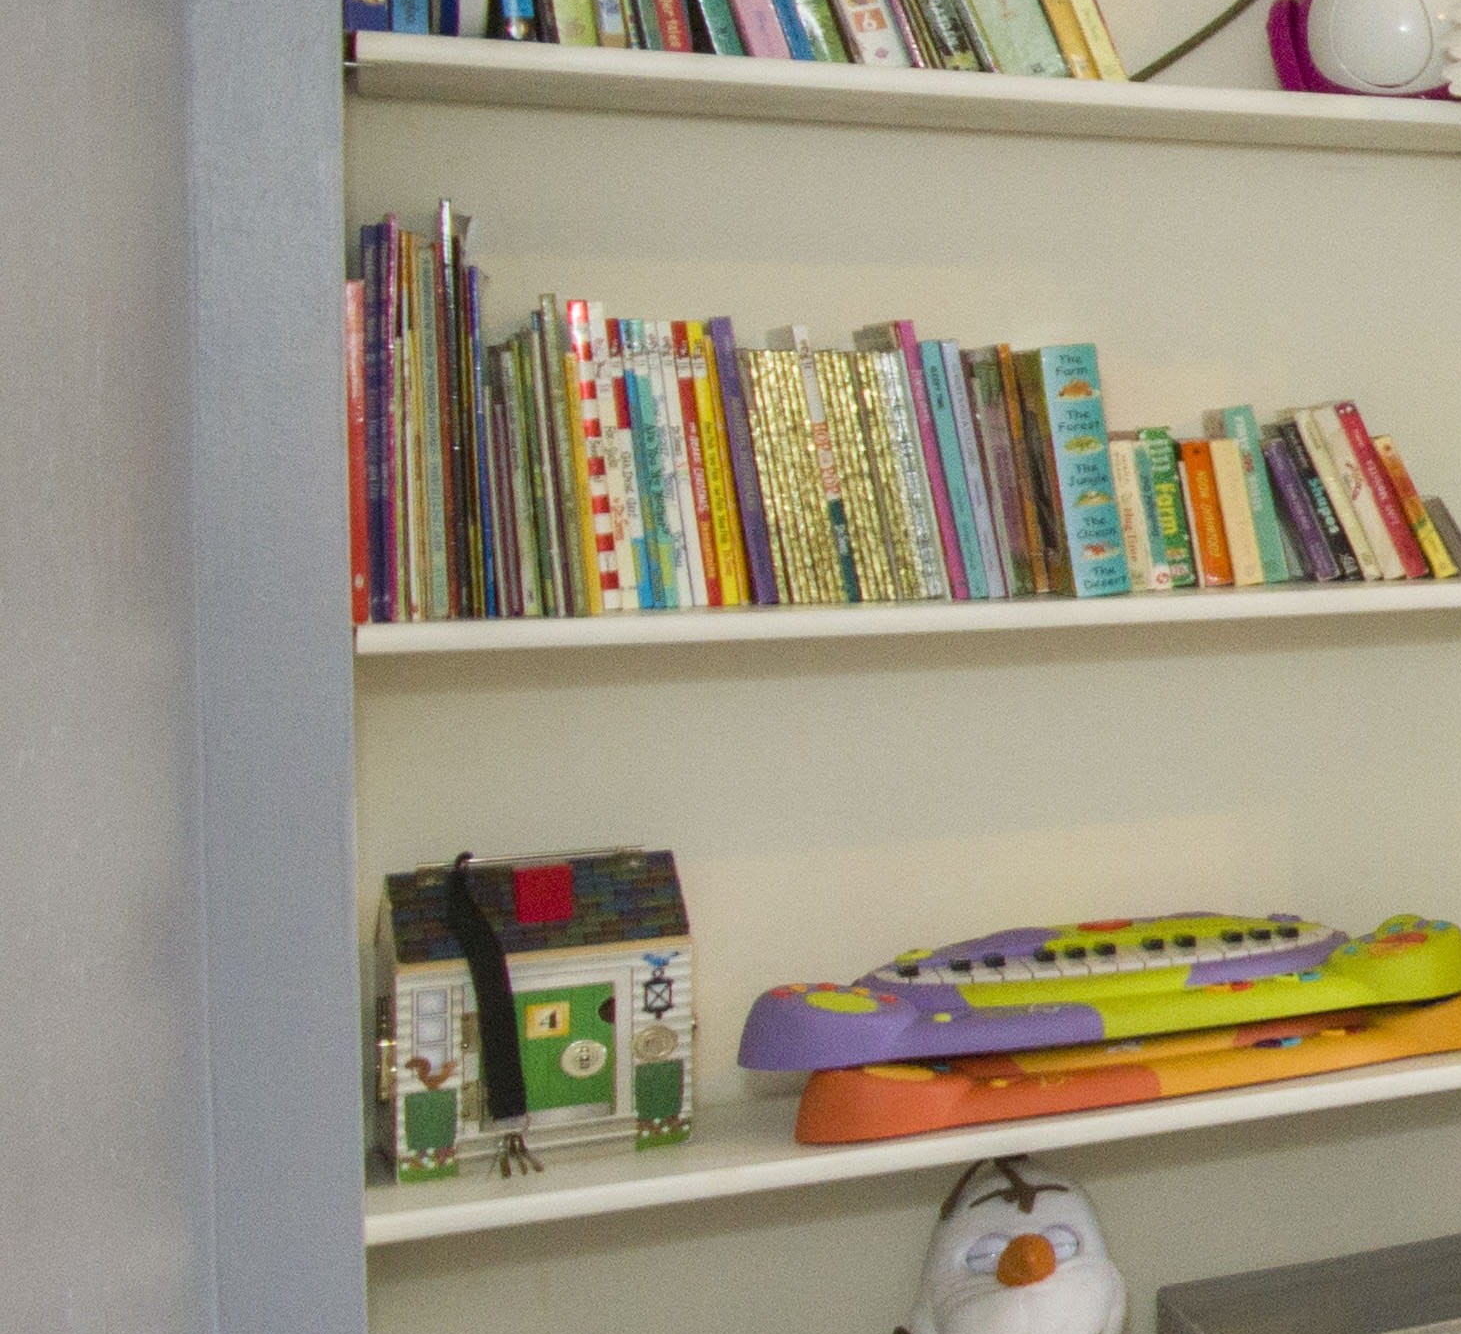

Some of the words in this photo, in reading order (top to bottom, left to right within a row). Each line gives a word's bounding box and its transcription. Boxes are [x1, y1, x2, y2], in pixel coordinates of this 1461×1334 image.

[1058, 353, 1083, 365] The
[1055, 365, 1088, 377] Farm
[1064, 409, 1090, 421] The
[1058, 420, 1100, 432] Forest
[811, 420, 833, 453] HOP
[1075, 463, 1098, 475] The
[819, 464, 841, 496] POP
[1068, 474, 1108, 488] Jungle
[1194, 468, 1211, 499] MOON
[1153, 482, 1179, 537] Farm
[1304, 474, 1341, 537] Shapes
[1082, 515, 1105, 527] The
[1120, 506, 1135, 531] Hug
[1093, 565, 1116, 576] The
[538, 1009, 558, 1029] 4
